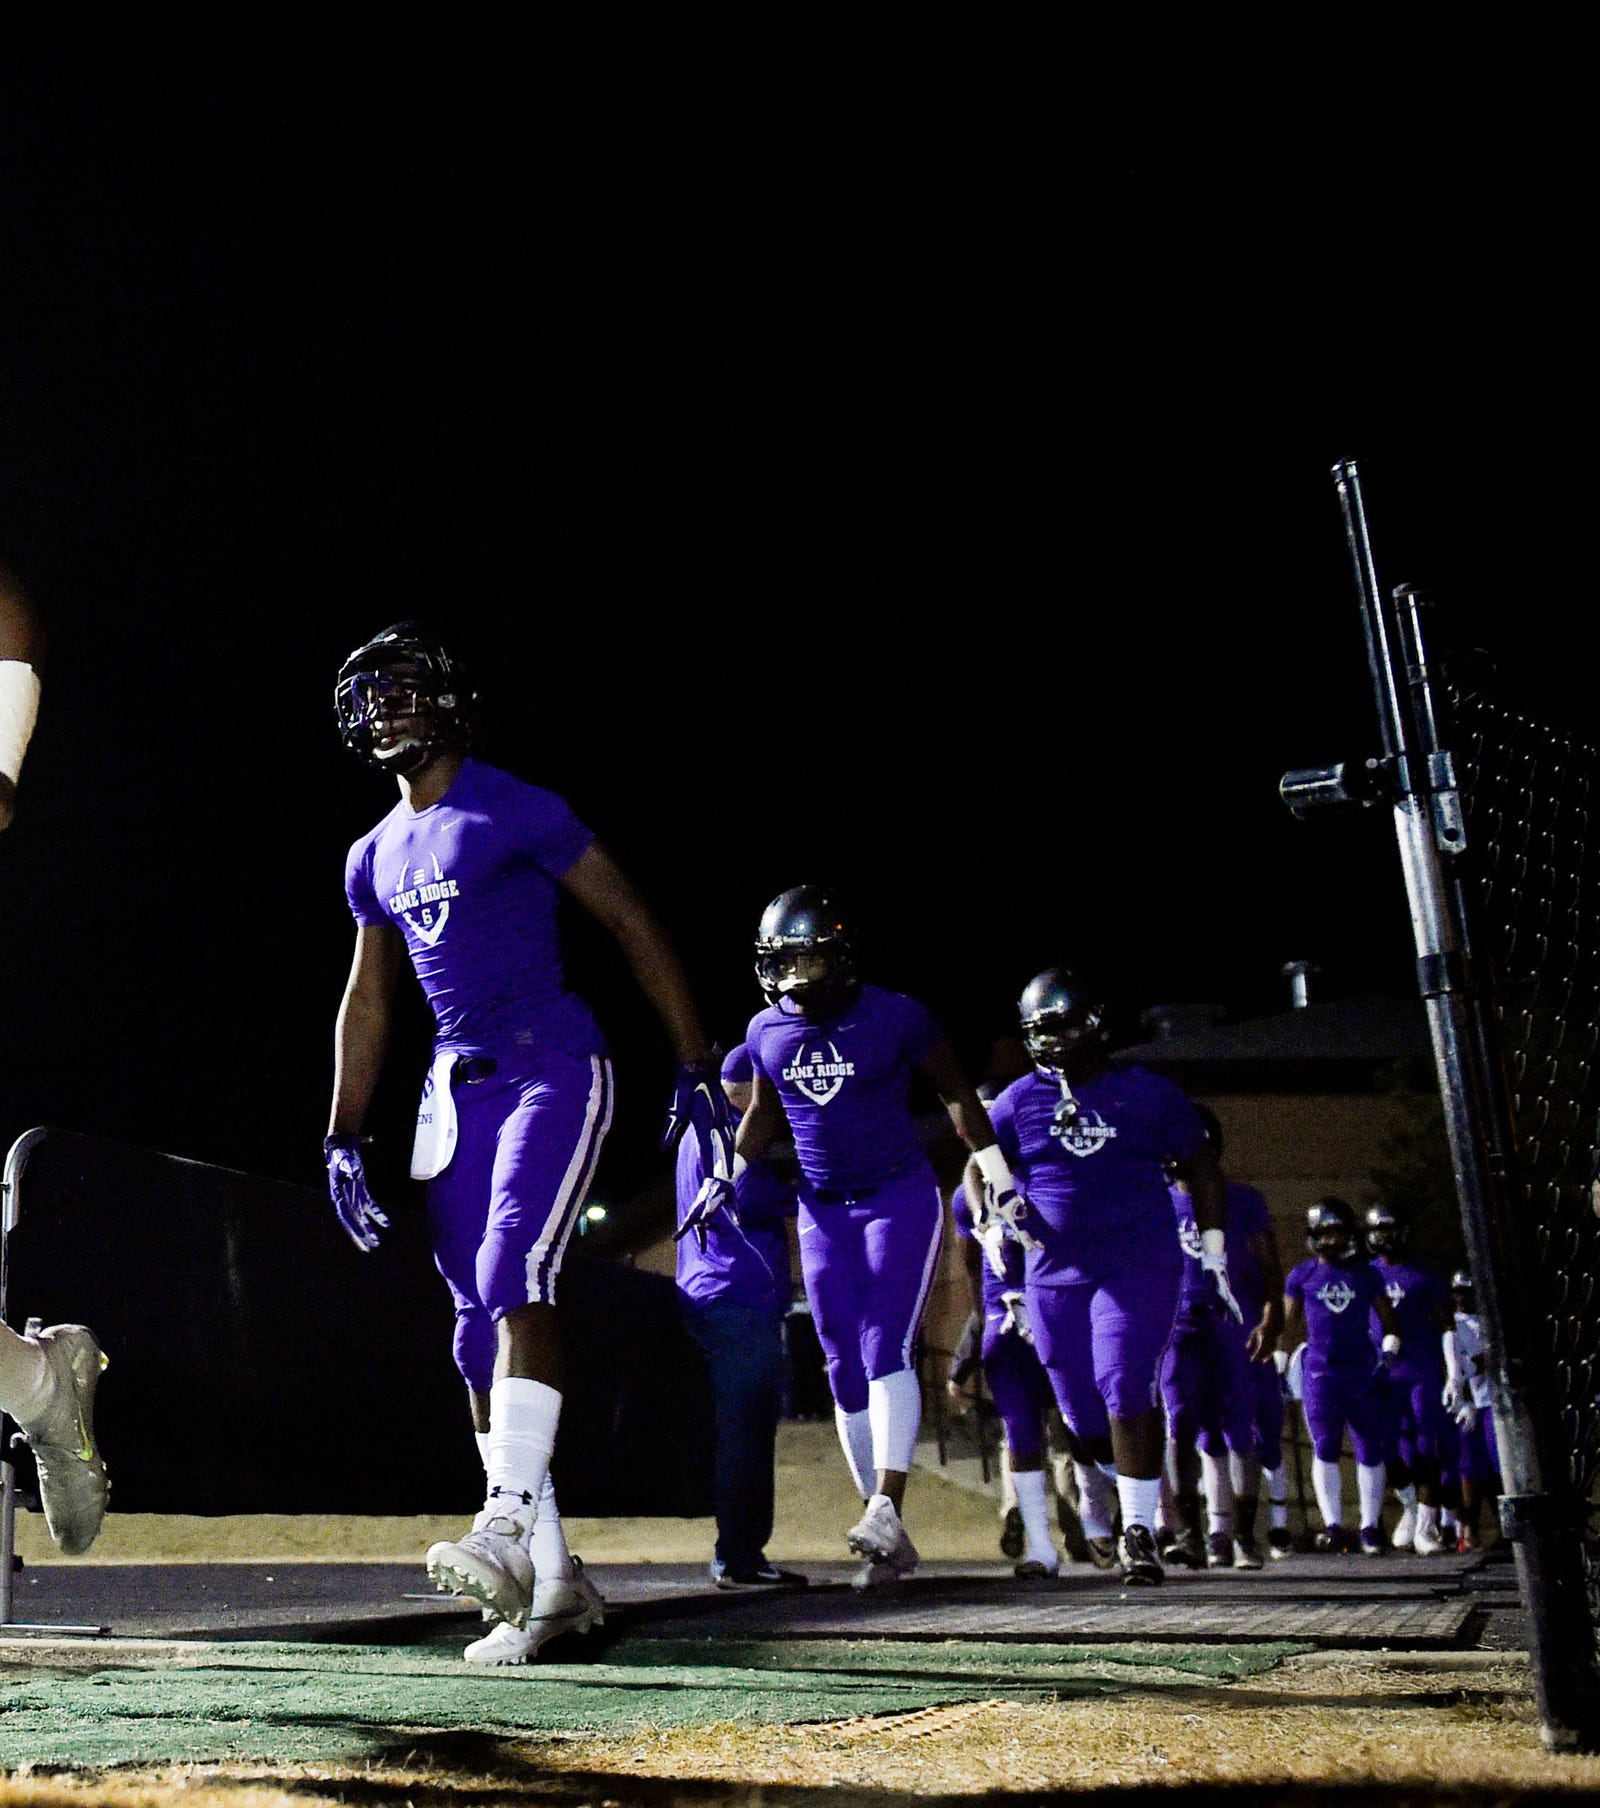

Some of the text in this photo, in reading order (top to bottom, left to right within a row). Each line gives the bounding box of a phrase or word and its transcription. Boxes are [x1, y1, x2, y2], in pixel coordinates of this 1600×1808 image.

[389, 879, 460, 914] CANE RIDGE
[421, 908, 433, 925] 6
[782, 1062, 855, 1081] CANE RIDGE
[811, 1078, 829, 1092] 21
